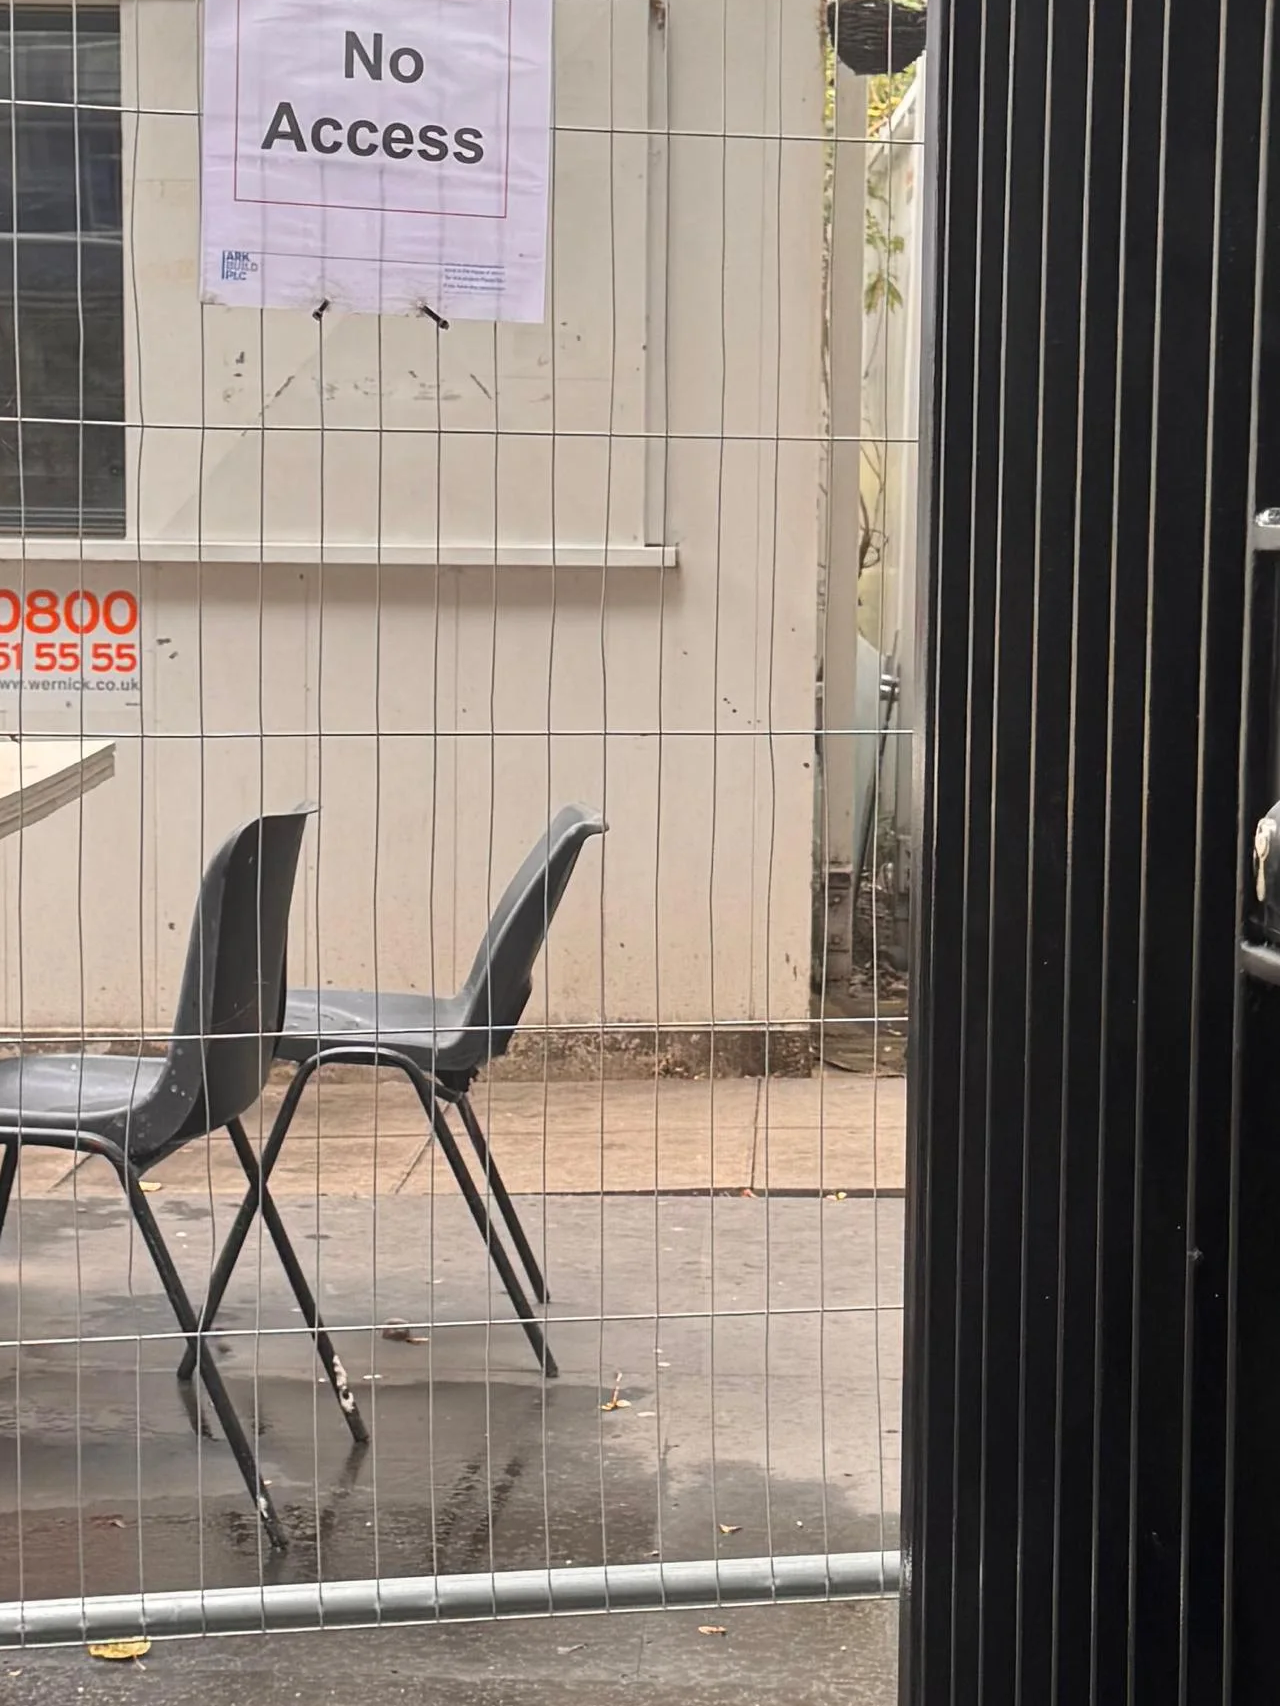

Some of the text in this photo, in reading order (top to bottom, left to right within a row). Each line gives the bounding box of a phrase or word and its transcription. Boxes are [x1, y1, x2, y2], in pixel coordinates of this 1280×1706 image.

[343, 30, 425, 84] No
[260, 101, 484, 165] Access
[226, 251, 250, 261] ARK
[225, 270, 247, 281] PLC
[34, 642, 81, 672] 55
[91, 642, 138, 673] 55
